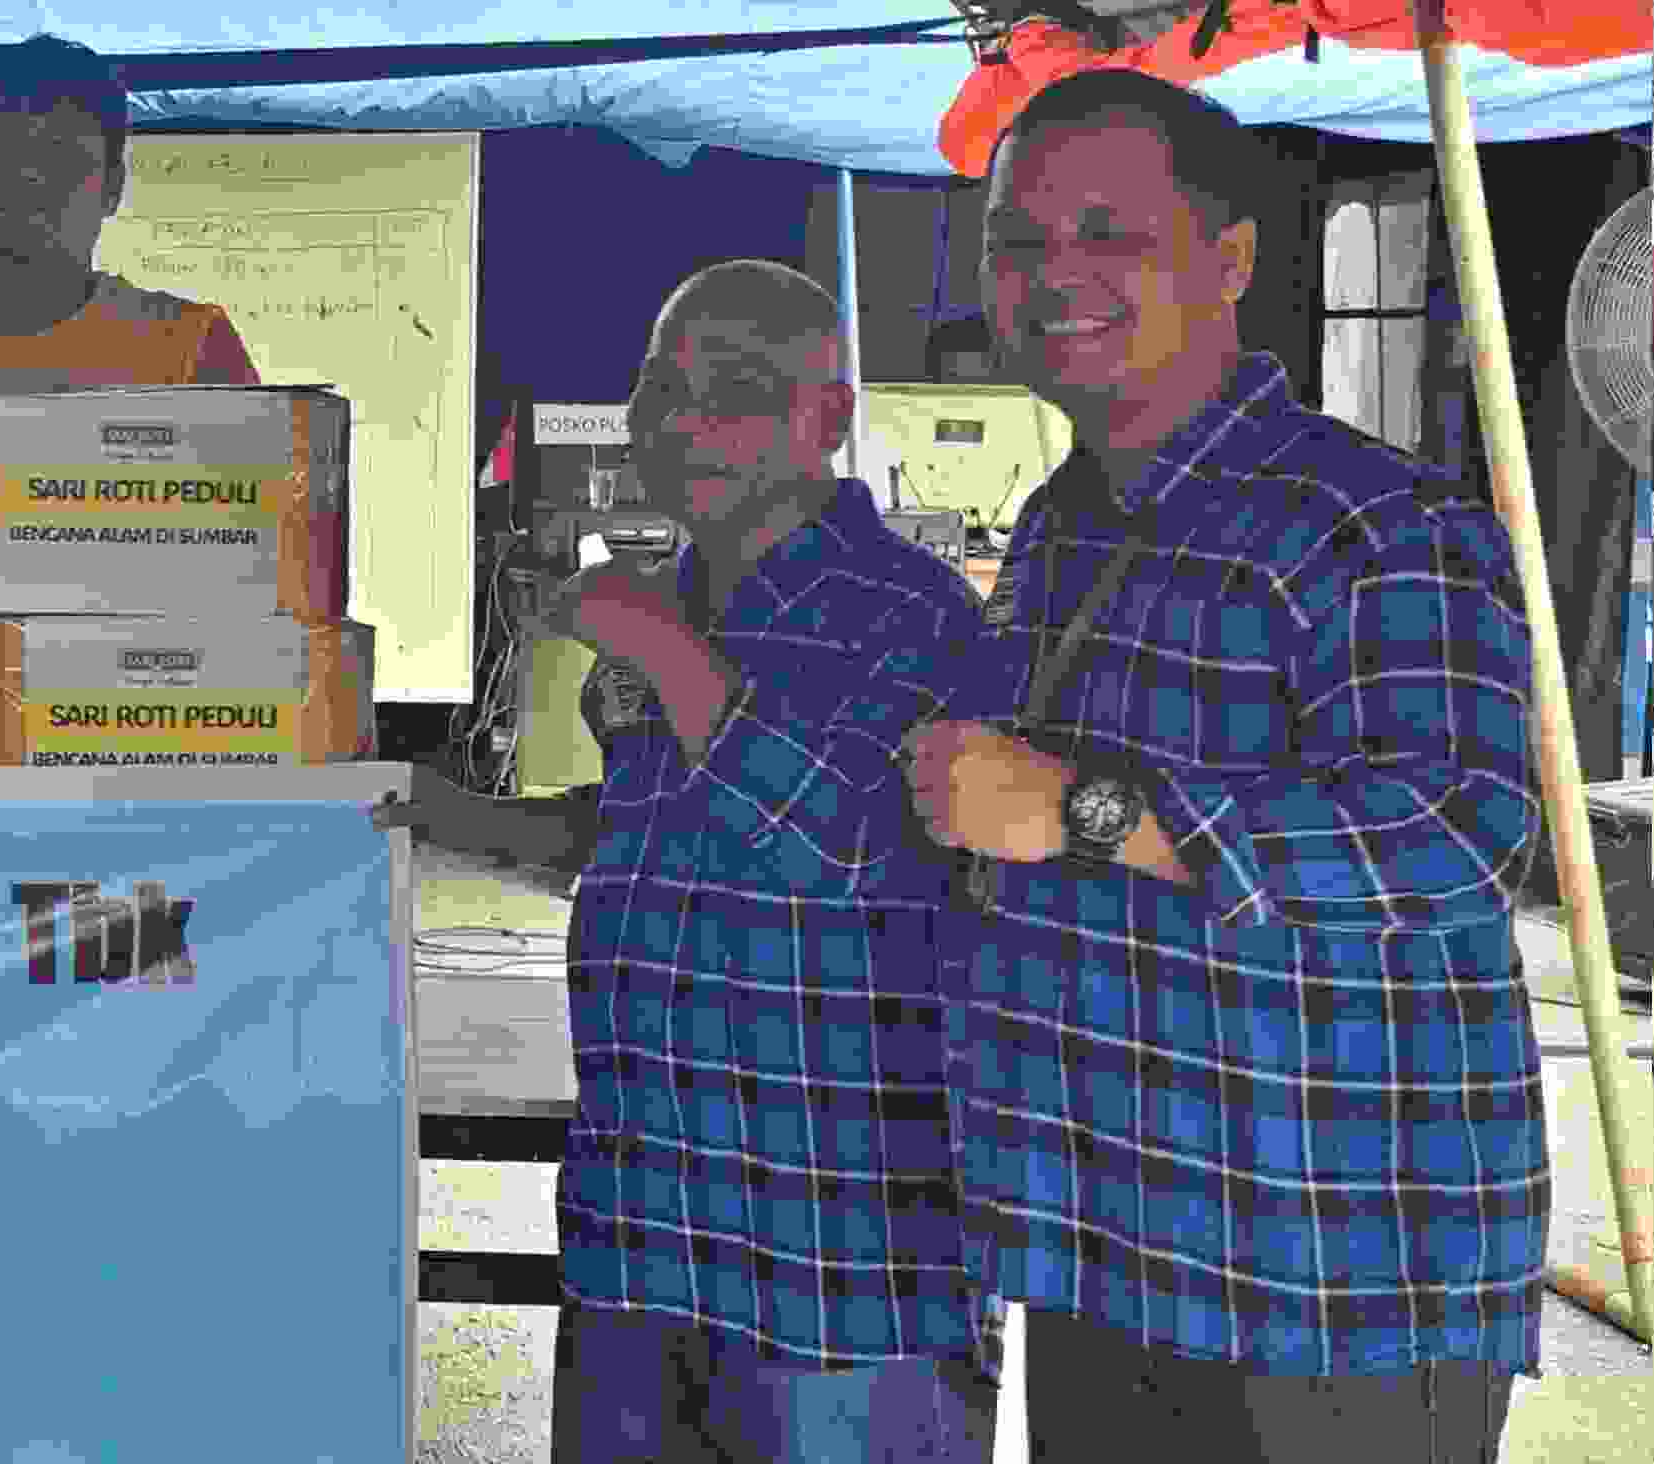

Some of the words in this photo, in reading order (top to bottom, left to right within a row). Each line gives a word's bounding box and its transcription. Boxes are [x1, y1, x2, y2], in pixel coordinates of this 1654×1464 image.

[29, 480, 85, 502] SARI
[99, 480, 160, 502] ROTI
[167, 481, 257, 504] PEDULI
[51, 704, 108, 727] SARI
[117, 704, 177, 727] ROTI
[185, 704, 277, 727] PEDULI
[10, 880, 197, 987] Tbk
